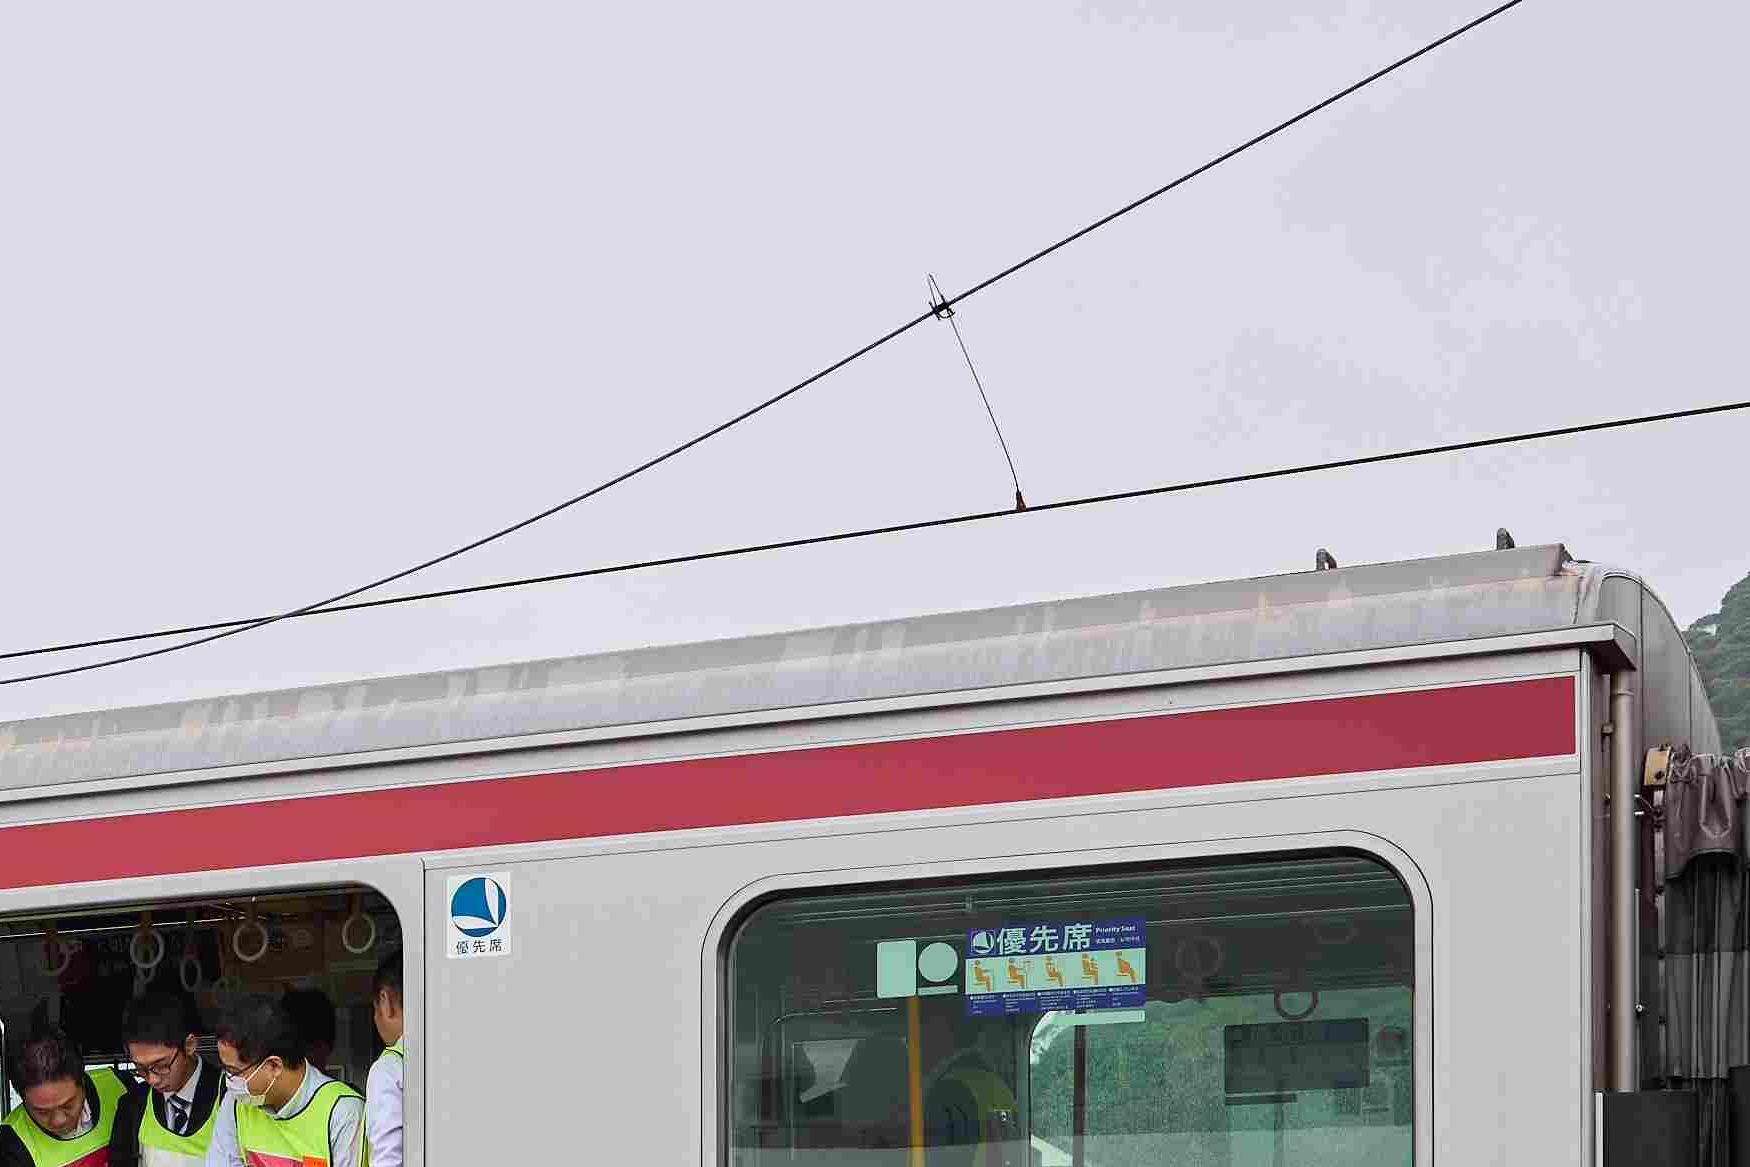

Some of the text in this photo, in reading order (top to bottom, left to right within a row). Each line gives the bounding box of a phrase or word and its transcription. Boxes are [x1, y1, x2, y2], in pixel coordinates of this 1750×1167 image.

[456, 939, 503, 954] 優先席
[997, 923, 1092, 955] 優先席
